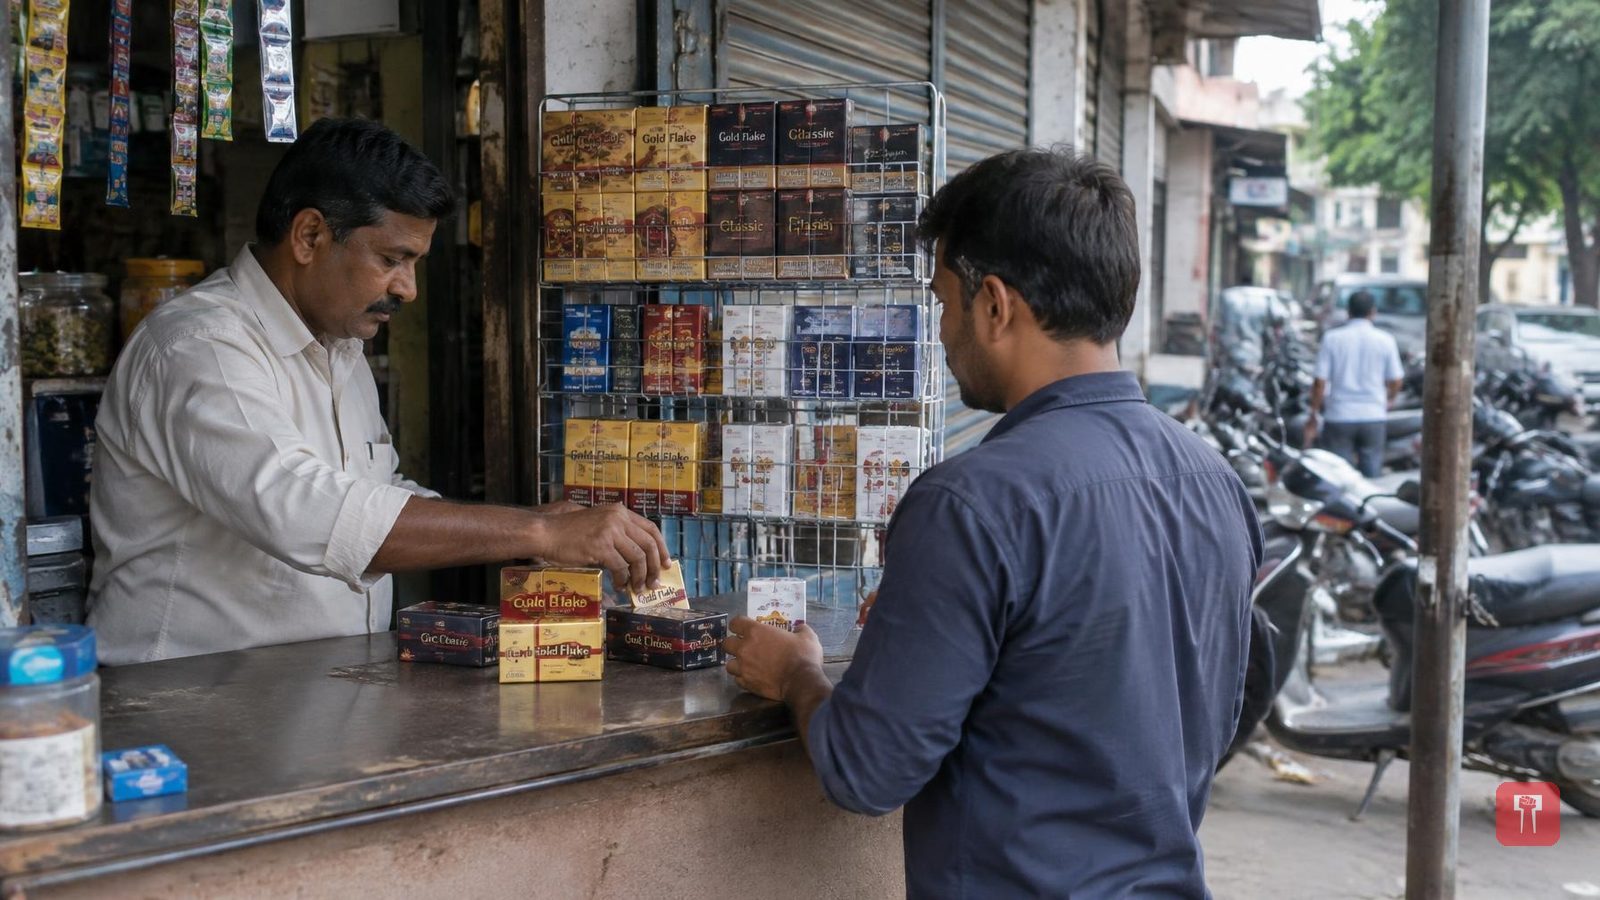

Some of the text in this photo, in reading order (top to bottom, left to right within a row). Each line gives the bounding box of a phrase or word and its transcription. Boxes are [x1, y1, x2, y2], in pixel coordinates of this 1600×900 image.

[642, 131, 697, 144] Gold Flake
[718, 131, 740, 142] Gold
